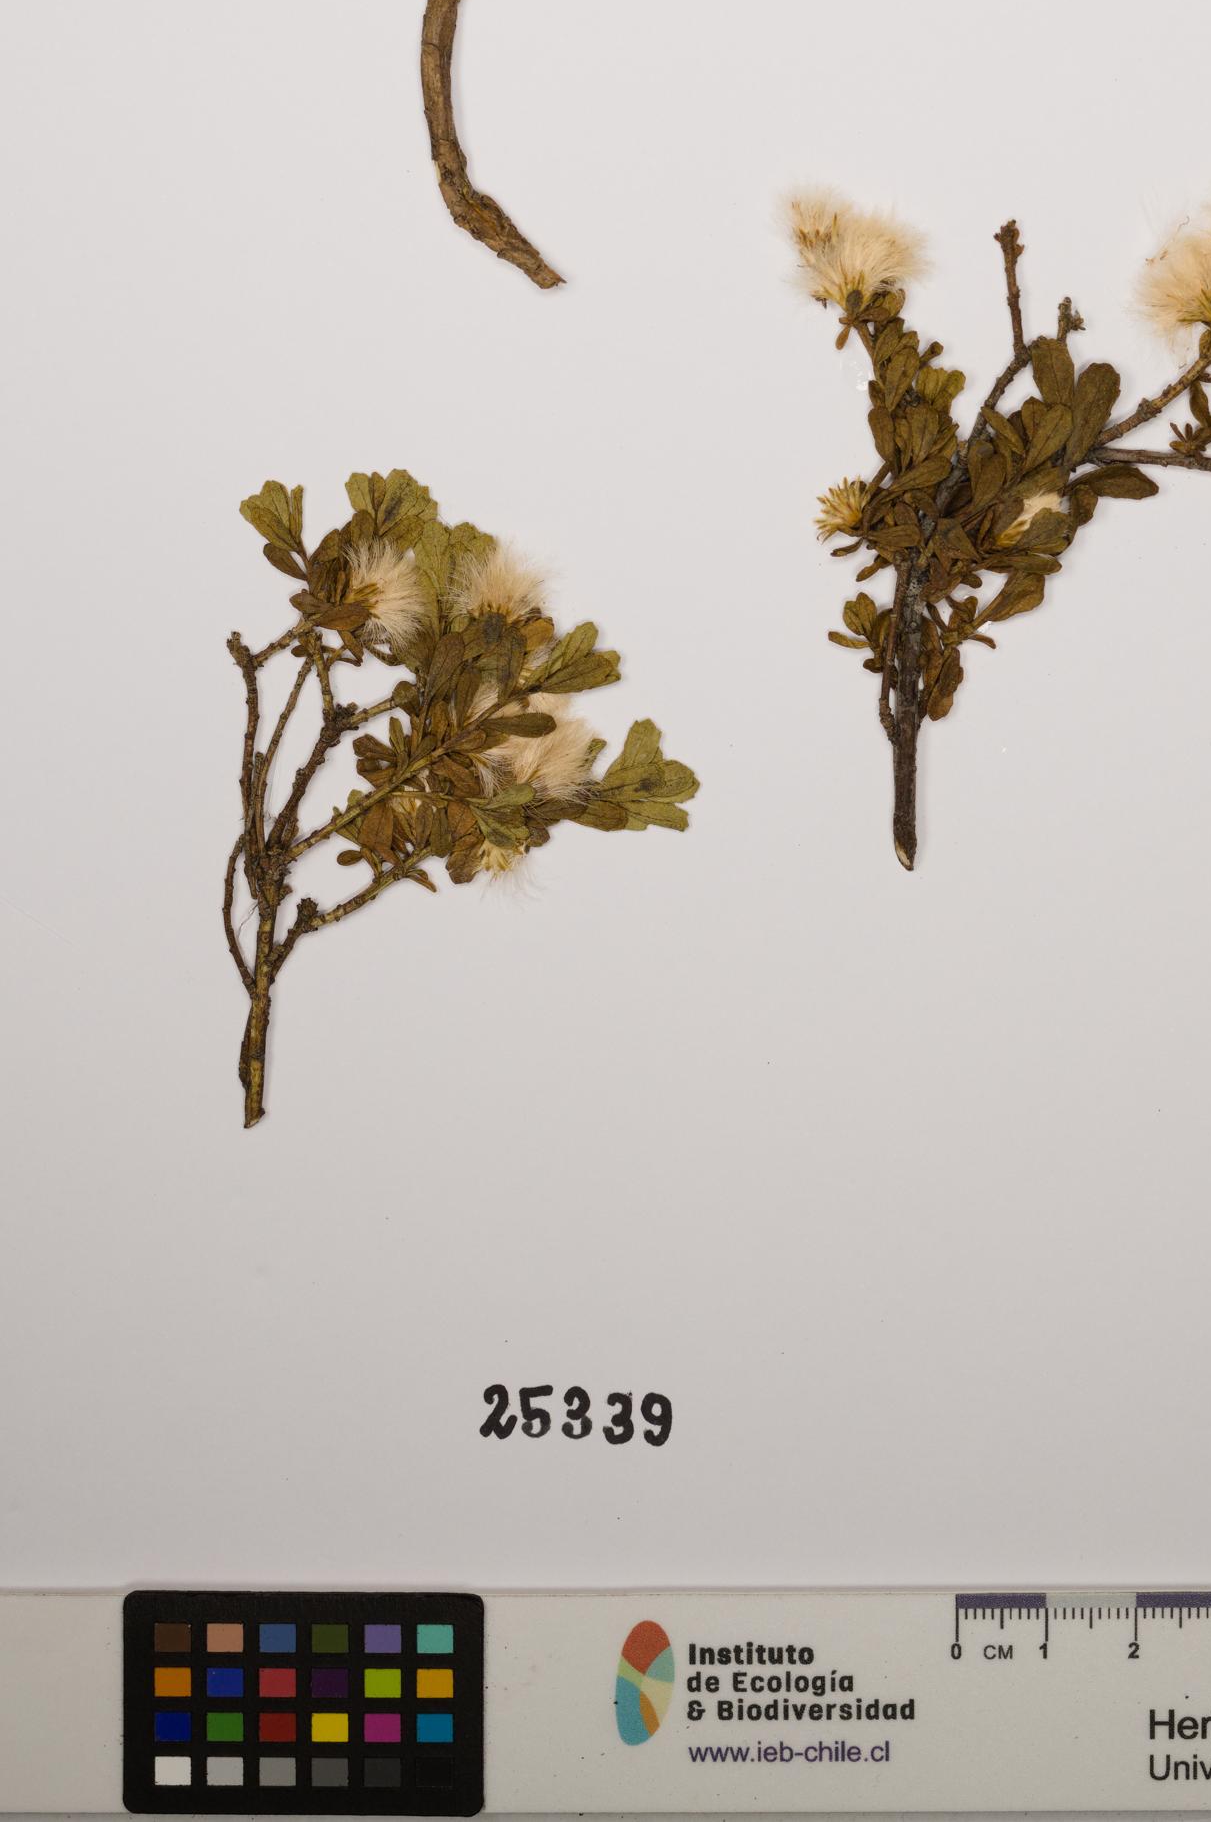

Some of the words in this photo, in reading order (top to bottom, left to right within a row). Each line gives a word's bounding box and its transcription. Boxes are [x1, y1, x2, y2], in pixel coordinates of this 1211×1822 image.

[479, 1384, 673, 1447] 25339
[688, 1641, 815, 1666] Instituto
[950, 1642, 962, 1660] 0
[983, 1644, 1014, 1661] CM
[1038, 1642, 1049, 1660] 1
[1127, 1641, 1140, 1660] 2
[686, 1671, 720, 1694] de
[731, 1669, 855, 1696] Ecología
[686, 1699, 706, 1722] &
[717, 1698, 915, 1721] Biodiversidad
[687, 1740, 890, 1763] www.ieb-chile.cl
